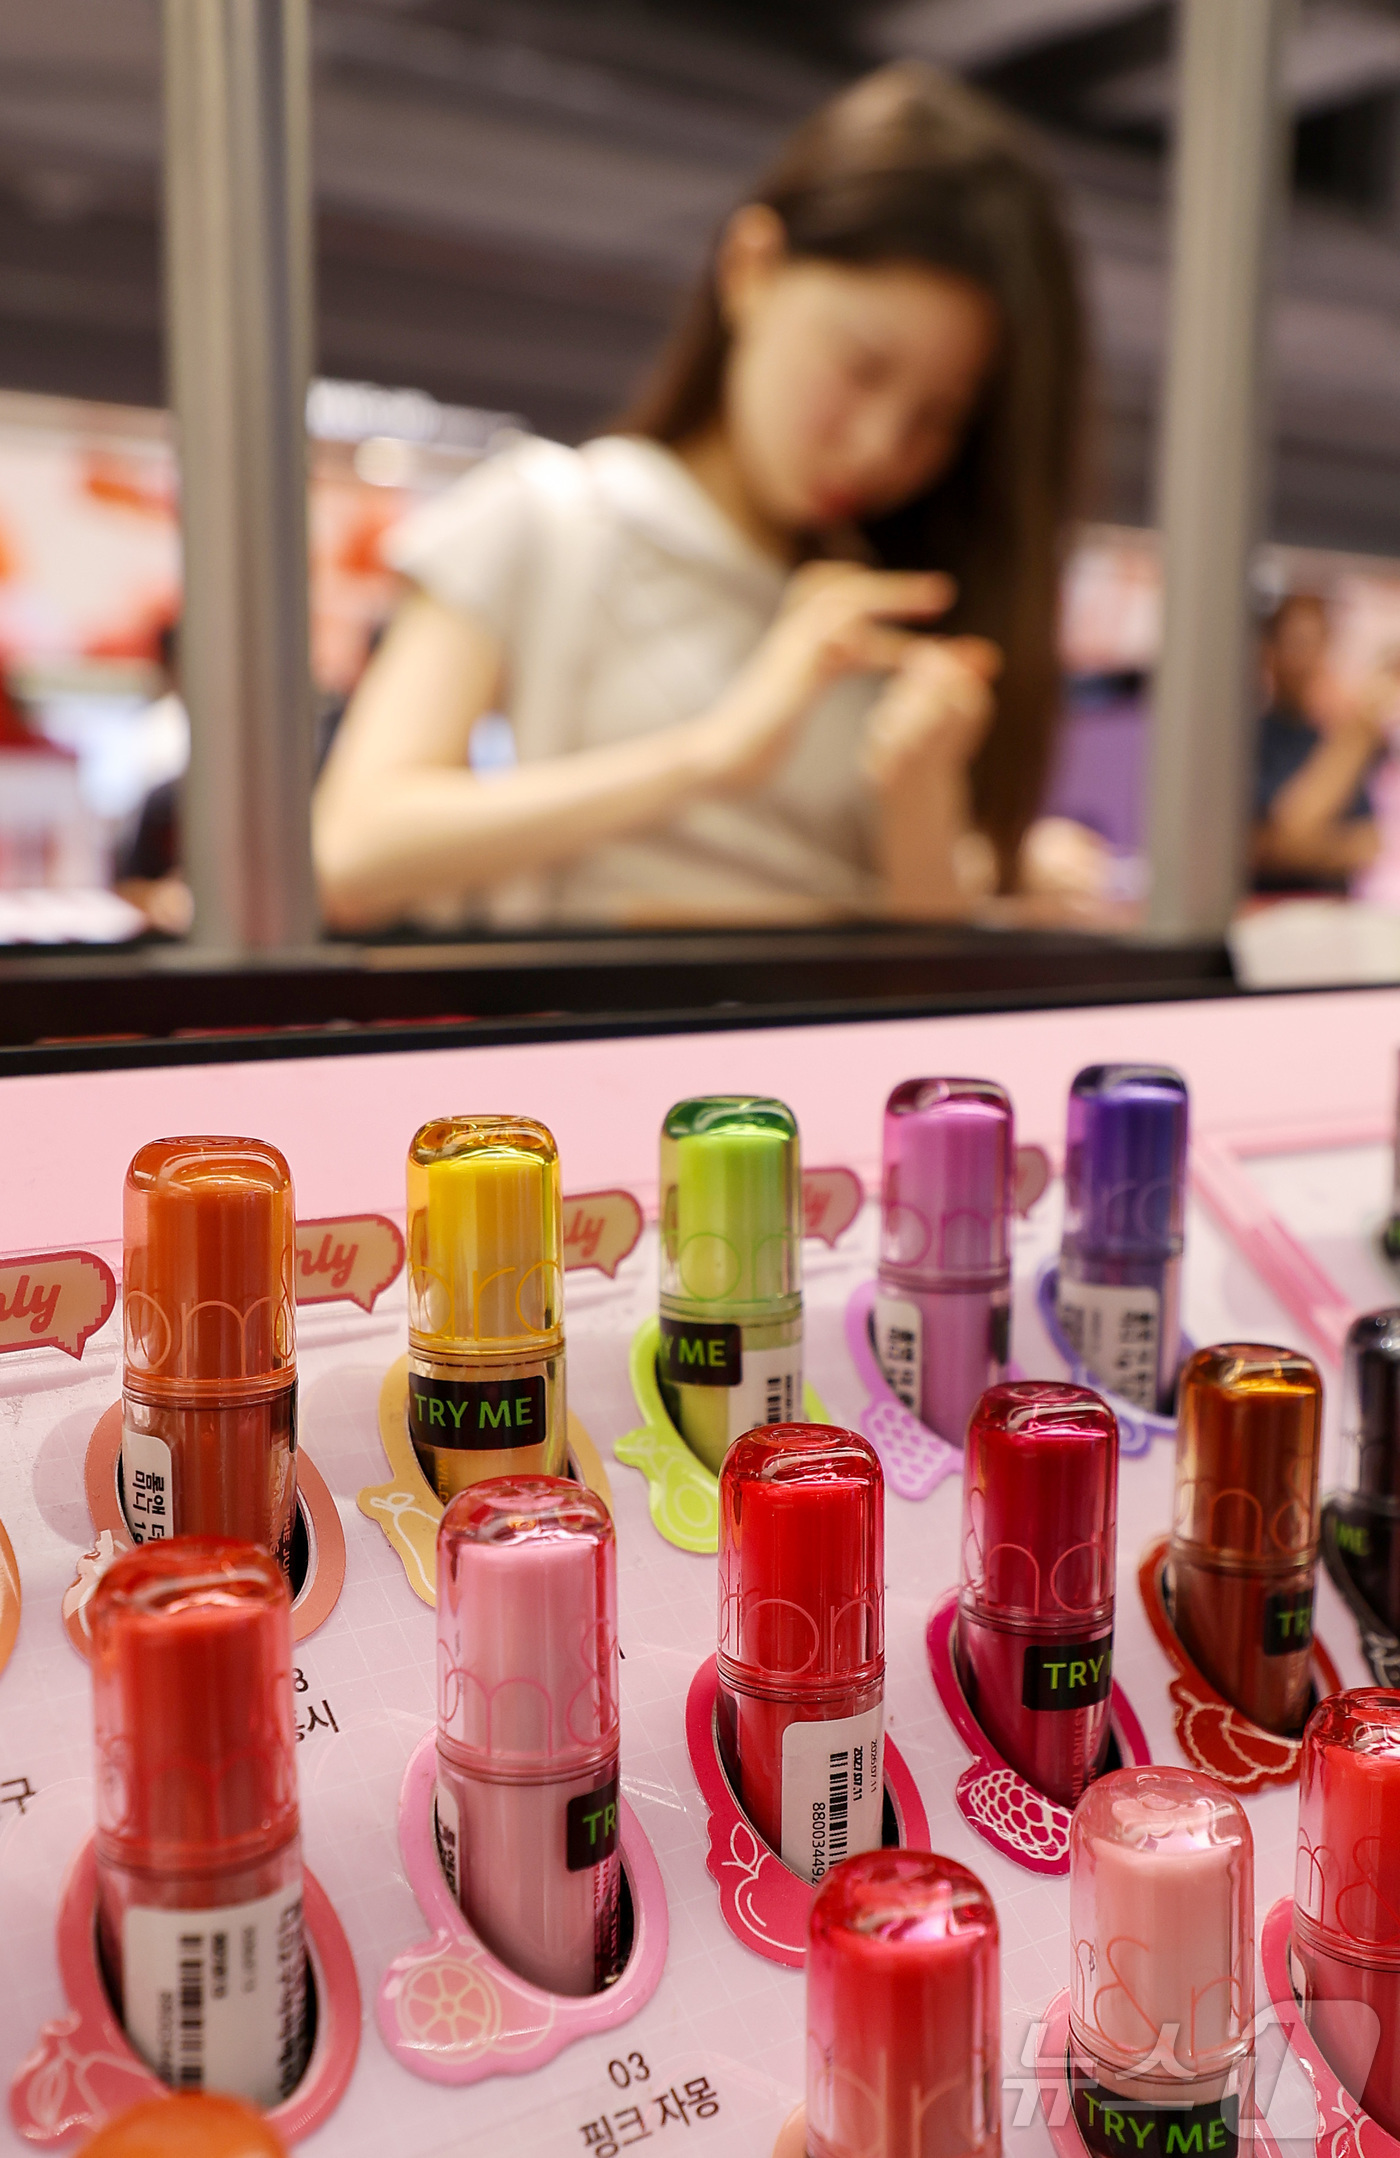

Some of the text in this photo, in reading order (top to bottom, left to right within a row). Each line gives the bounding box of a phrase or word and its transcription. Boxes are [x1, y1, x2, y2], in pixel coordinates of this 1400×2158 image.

[678, 1337, 727, 1368] ME
[414, 1393, 533, 1429] TRY ME
[132, 1470, 147, 1512] 미니
[146, 1472, 165, 1516] 롬앤
[1043, 1654, 1106, 1691] TRY
[608, 2052, 650, 2088] 03
[580, 2076, 719, 2158] 핑크 자몽
[1082, 2090, 1226, 2155] TRY ME
